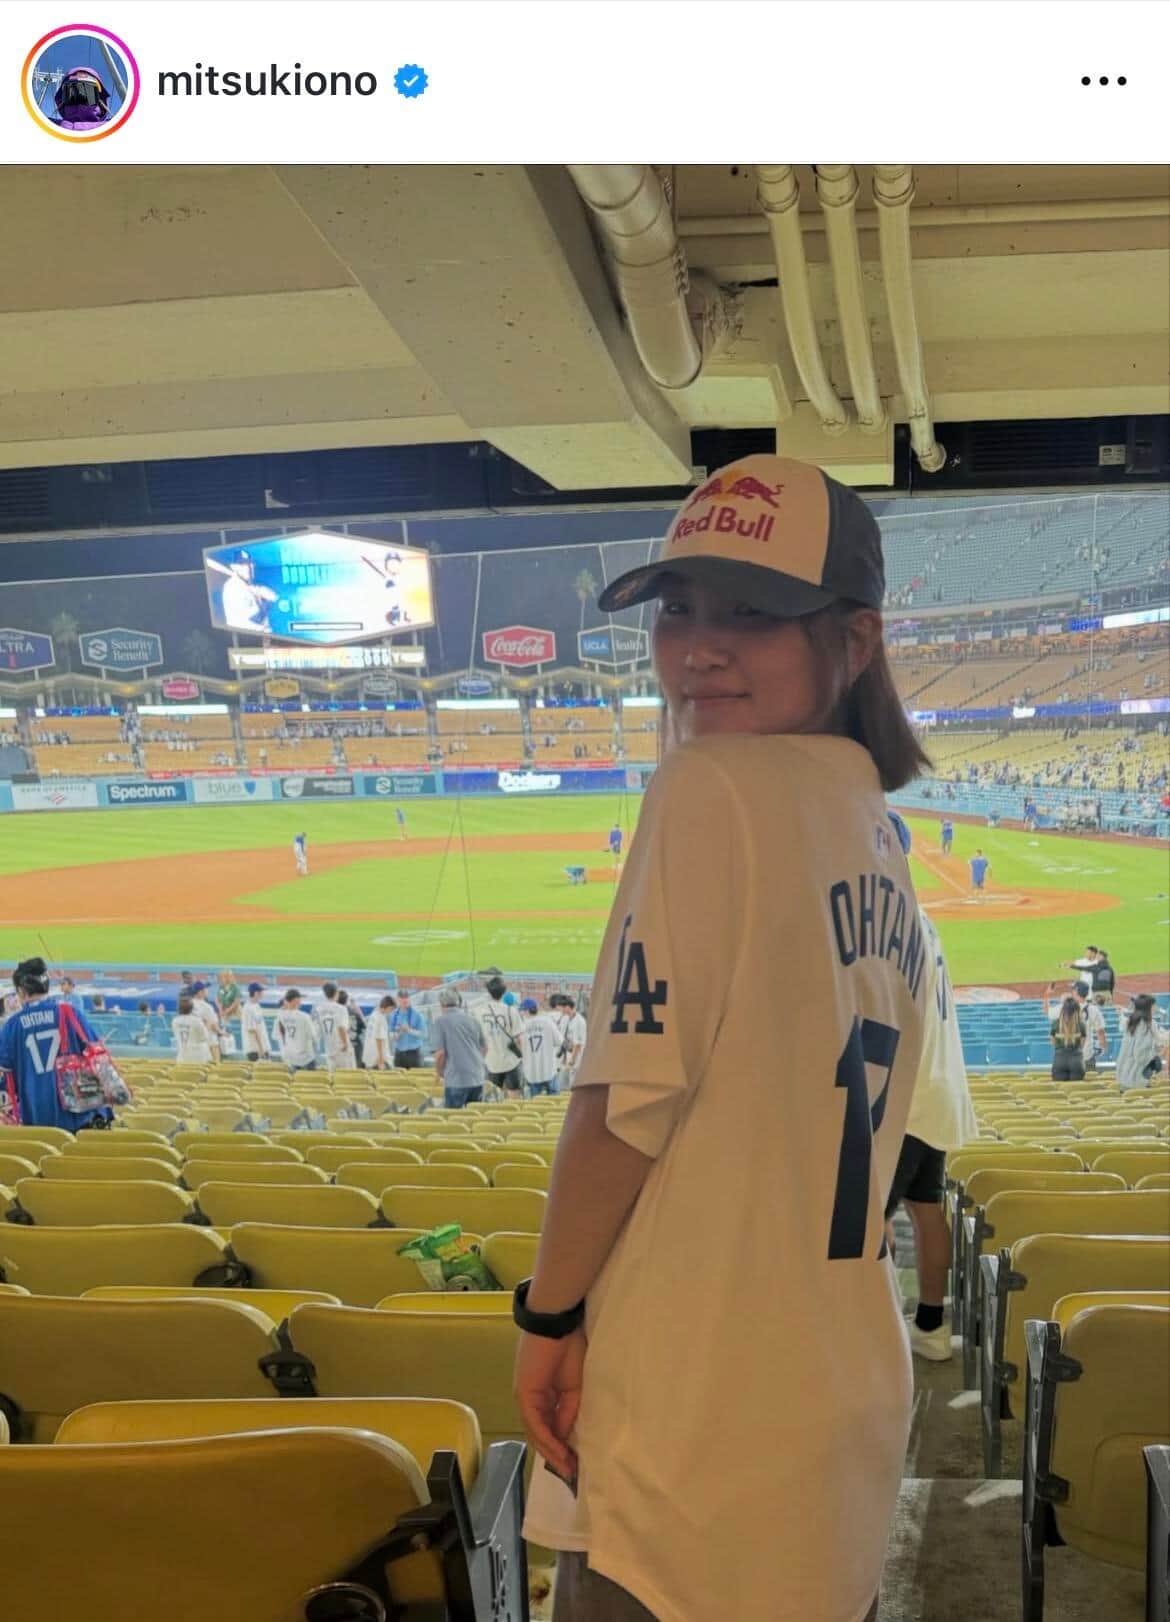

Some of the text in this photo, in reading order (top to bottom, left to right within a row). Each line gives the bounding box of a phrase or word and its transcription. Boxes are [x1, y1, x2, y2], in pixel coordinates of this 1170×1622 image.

[672, 505, 775, 544] Red Bull
[111, 639, 153, 655] Security
[583, 640, 608, 650] UCLA
[113, 649, 149, 662] Benefit
[111, 783, 177, 802] Spectrum
[20, 1010, 55, 1029] OHTANI
[25, 1029, 61, 1075] 17
[529, 1034, 543, 1052] 17
[827, 1014, 900, 1260] 17
